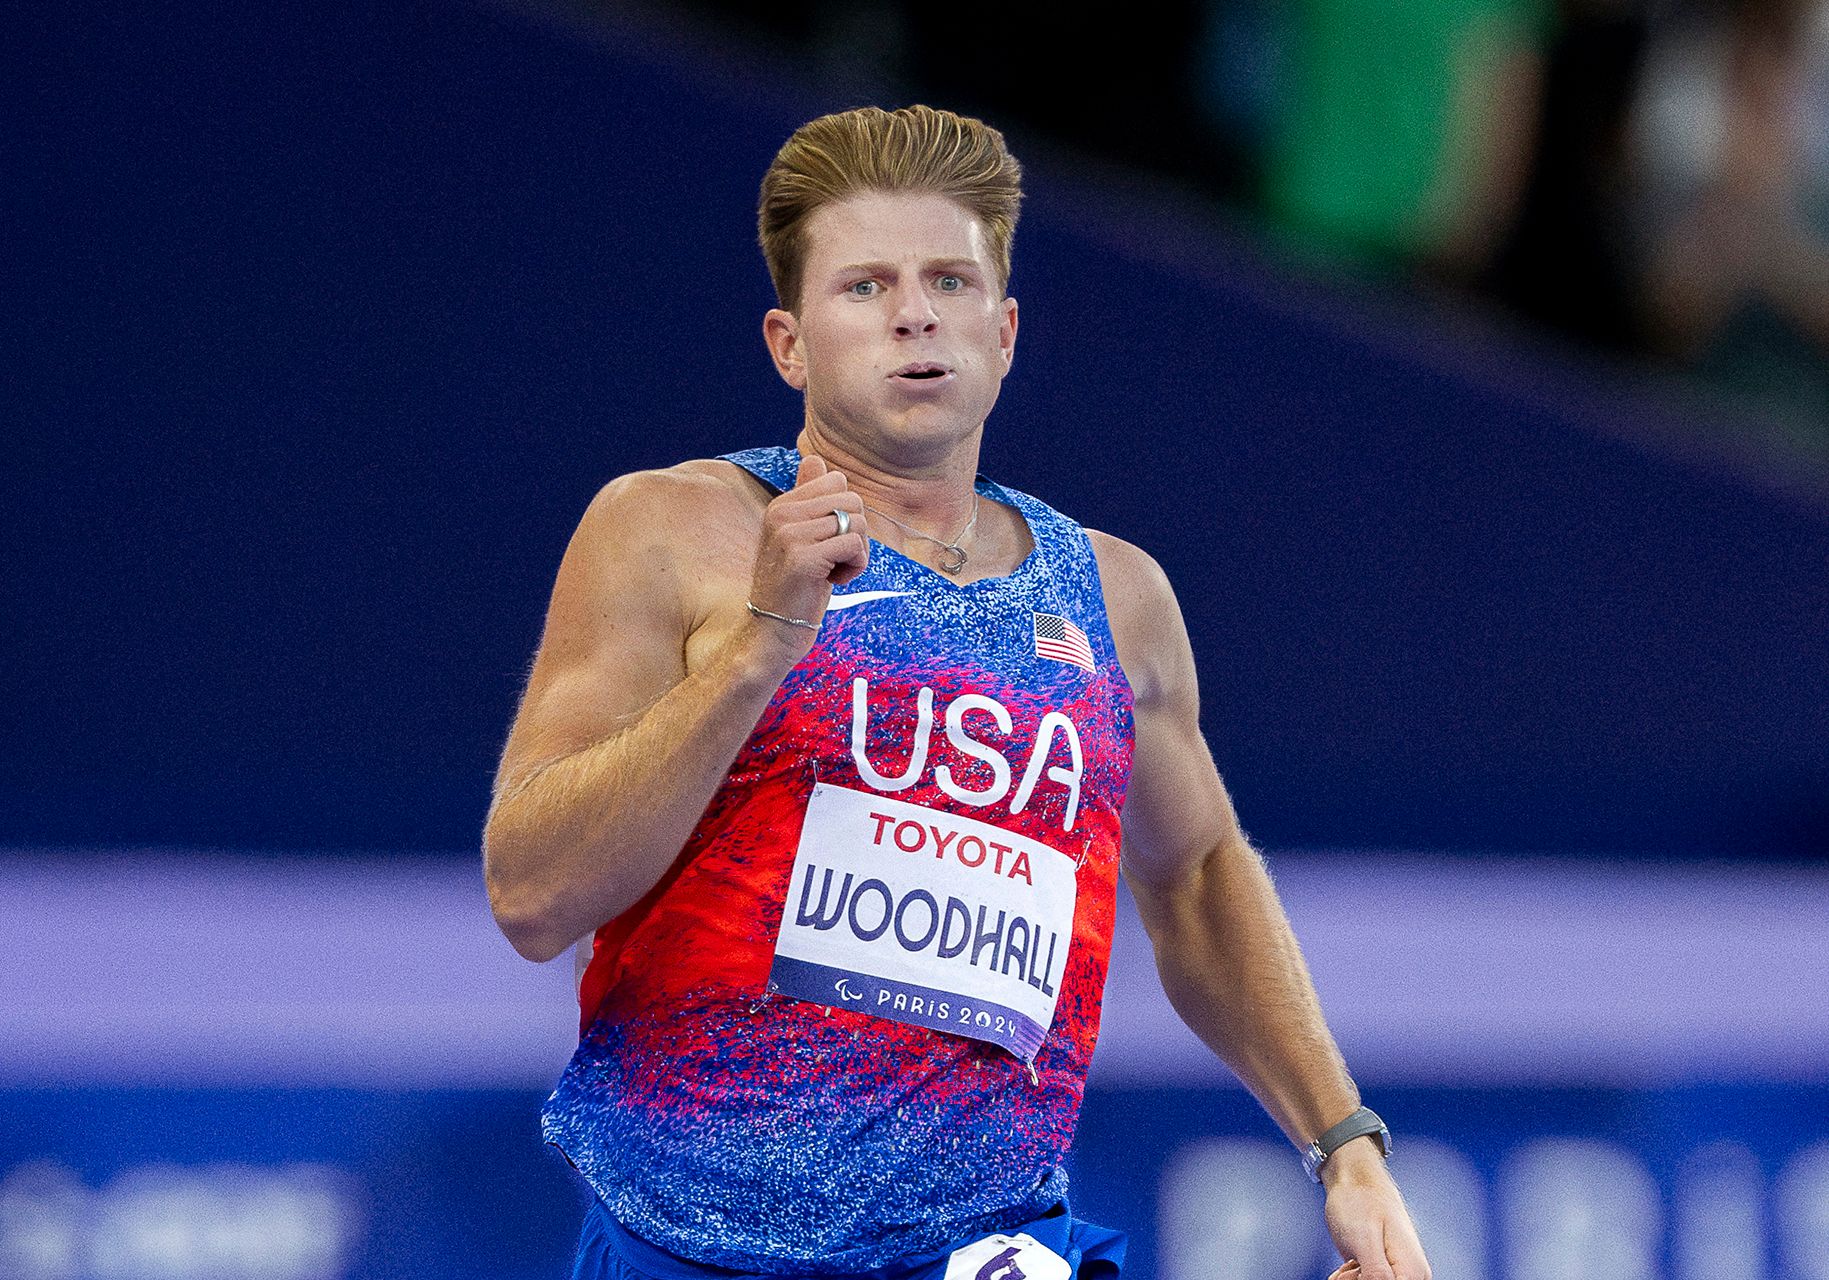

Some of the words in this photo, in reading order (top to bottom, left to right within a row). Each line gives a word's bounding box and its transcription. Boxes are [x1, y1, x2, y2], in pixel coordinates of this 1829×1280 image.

[851, 677, 1084, 832] USA
[869, 811, 1034, 886] TOYOTA
[795, 864, 1057, 998] WOODHALL
[877, 989, 951, 1020] PARIS
[958, 1007, 1017, 1038] 2024
